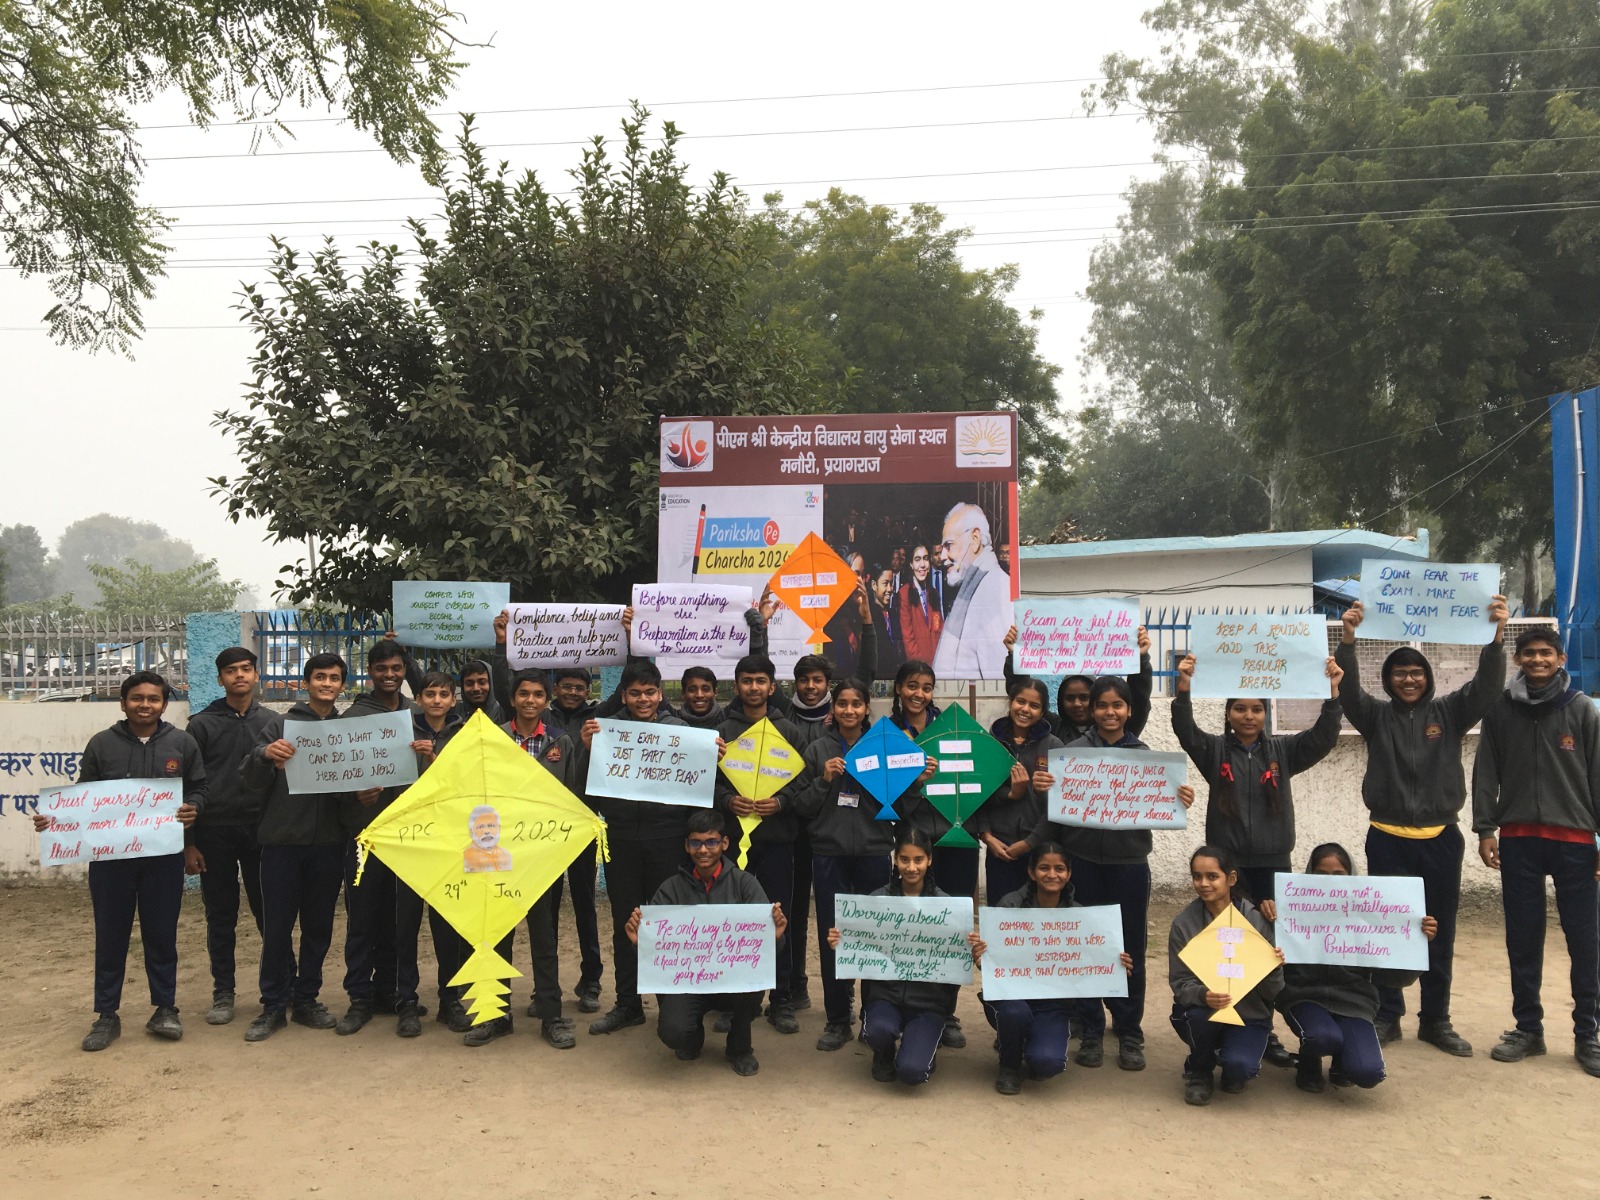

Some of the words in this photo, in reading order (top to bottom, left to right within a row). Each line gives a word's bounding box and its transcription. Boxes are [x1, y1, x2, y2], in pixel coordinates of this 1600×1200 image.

[716, 426, 748, 448] पीएम
[751, 425, 767, 447] श्री
[770, 425, 812, 450] केन्द्रीय
[814, 424, 861, 446] विद्यालय
[864, 430, 888, 454] वायु
[890, 424, 916, 445] सेना
[918, 428, 947, 445] स्थल
[824, 457, 881, 476] प्रयागराज
[710, 525, 760, 542] Pariksha
[766, 527, 778, 540] Pe
[706, 549, 754, 568] Charcha
[1424, 569, 1449, 581] FEAR
[1459, 572, 1479, 581] THE
[1426, 588, 1456, 599] MAKE
[679, 593, 729, 613] anything
[1376, 602, 1394, 614] THE
[1406, 605, 1438, 617] EXAM
[1451, 606, 1479, 617] FEAR
[571, 607, 597, 628] belief
[599, 609, 621, 621] and
[1023, 610, 1056, 626] Exam
[1061, 616, 1083, 627] are
[1087, 610, 1112, 631] just
[1114, 610, 1132, 628] the
[638, 621, 698, 645] Preparation
[710, 625, 725, 640] the
[728, 625, 748, 646] key
[1247, 622, 1258, 635] A
[1403, 621, 1426, 636] YOU
[513, 628, 553, 647] Practice
[557, 636, 574, 645] can
[577, 629, 598, 648] help
[600, 633, 619, 649] you
[1108, 634, 1129, 645] your
[517, 647, 528, 659] to
[531, 647, 559, 658] crack
[561, 648, 582, 663] any
[585, 648, 617, 657] exam
[660, 645, 673, 654] to
[1084, 643, 1096, 656] let
[1216, 642, 1242, 654] AND
[1254, 642, 1278, 656] TAKE
[1052, 661, 1076, 674] your
[1080, 659, 1122, 674] progress
[1242, 659, 1287, 674] REGULAR
[1238, 675, 1281, 690] BREAKS
[328, 734, 342, 745] ON
[348, 732, 372, 743] WHAT
[379, 728, 397, 739] YOU
[637, 732, 660, 745] EXAM
[668, 735, 680, 748] IS
[371, 748, 388, 759] THE
[613, 746, 634, 760] JUST
[641, 748, 666, 763] PART
[671, 752, 688, 765] OF
[39, 752, 84, 781] साइ
[606, 763, 630, 778] YOUR
[636, 767, 672, 781] MASTER
[1097, 759, 1128, 779] tension
[1110, 778, 1127, 794] that
[1128, 780, 1148, 794] you
[12, 795, 39, 815] पर
[49, 790, 89, 810] Trust
[92, 787, 151, 812] yourself
[150, 791, 174, 808] you
[1062, 790, 1084, 802] about
[1088, 793, 1111, 806] your
[1114, 792, 1141, 808] future
[49, 816, 80, 833] know
[87, 819, 118, 831] more
[123, 812, 152, 828] than
[152, 815, 174, 831] you
[1113, 809, 1140, 824] your
[512, 820, 572, 842] 2024
[49, 841, 81, 860] think
[92, 845, 114, 860] you
[122, 836, 143, 853] do
[493, 883, 522, 899] Jan
[1285, 882, 1326, 897] Exams
[1330, 889, 1349, 898] are
[1352, 886, 1373, 898] not
[1374, 890, 1383, 899] a
[907, 908, 952, 926] about
[1288, 902, 1338, 912] measure
[1341, 901, 1349, 917] of
[675, 917, 698, 941] only
[702, 924, 720, 941] way
[722, 917, 732, 932] to
[999, 921, 1034, 931] COMPARE
[1041, 920, 1081, 932] YOURSELF
[1285, 918, 1311, 939] They
[1313, 924, 1330, 934] are
[1334, 924, 1341, 934] a
[1346, 924, 1397, 934] measure
[1401, 920, 1411, 939] of
[655, 940, 680, 955] exam
[683, 940, 714, 954] tension
[724, 934, 736, 952] by
[736, 938, 763, 954] facing
[911, 931, 946, 946] change
[949, 932, 965, 947] the
[1004, 936, 1025, 946] ONLY
[1029, 937, 1040, 946] TO
[1045, 935, 1061, 946] WHO
[1066, 937, 1081, 946] YOU
[1085, 934, 1105, 945] WERE
[1324, 933, 1391, 959] Preparation
[661, 955, 678, 971] head
[681, 956, 691, 970] on
[694, 953, 713, 967] and
[837, 955, 855, 965] and
[858, 956, 888, 973] giving
[893, 960, 915, 973] your
[919, 960, 940, 971] best
[890, 943, 914, 962] focus
[916, 947, 926, 956] on
[929, 947, 973, 970] preparing
[673, 970, 694, 985] your
[994, 968, 1005, 978] BE
[1009, 966, 1032, 978] YOUR
[1036, 964, 1055, 977] OWN
